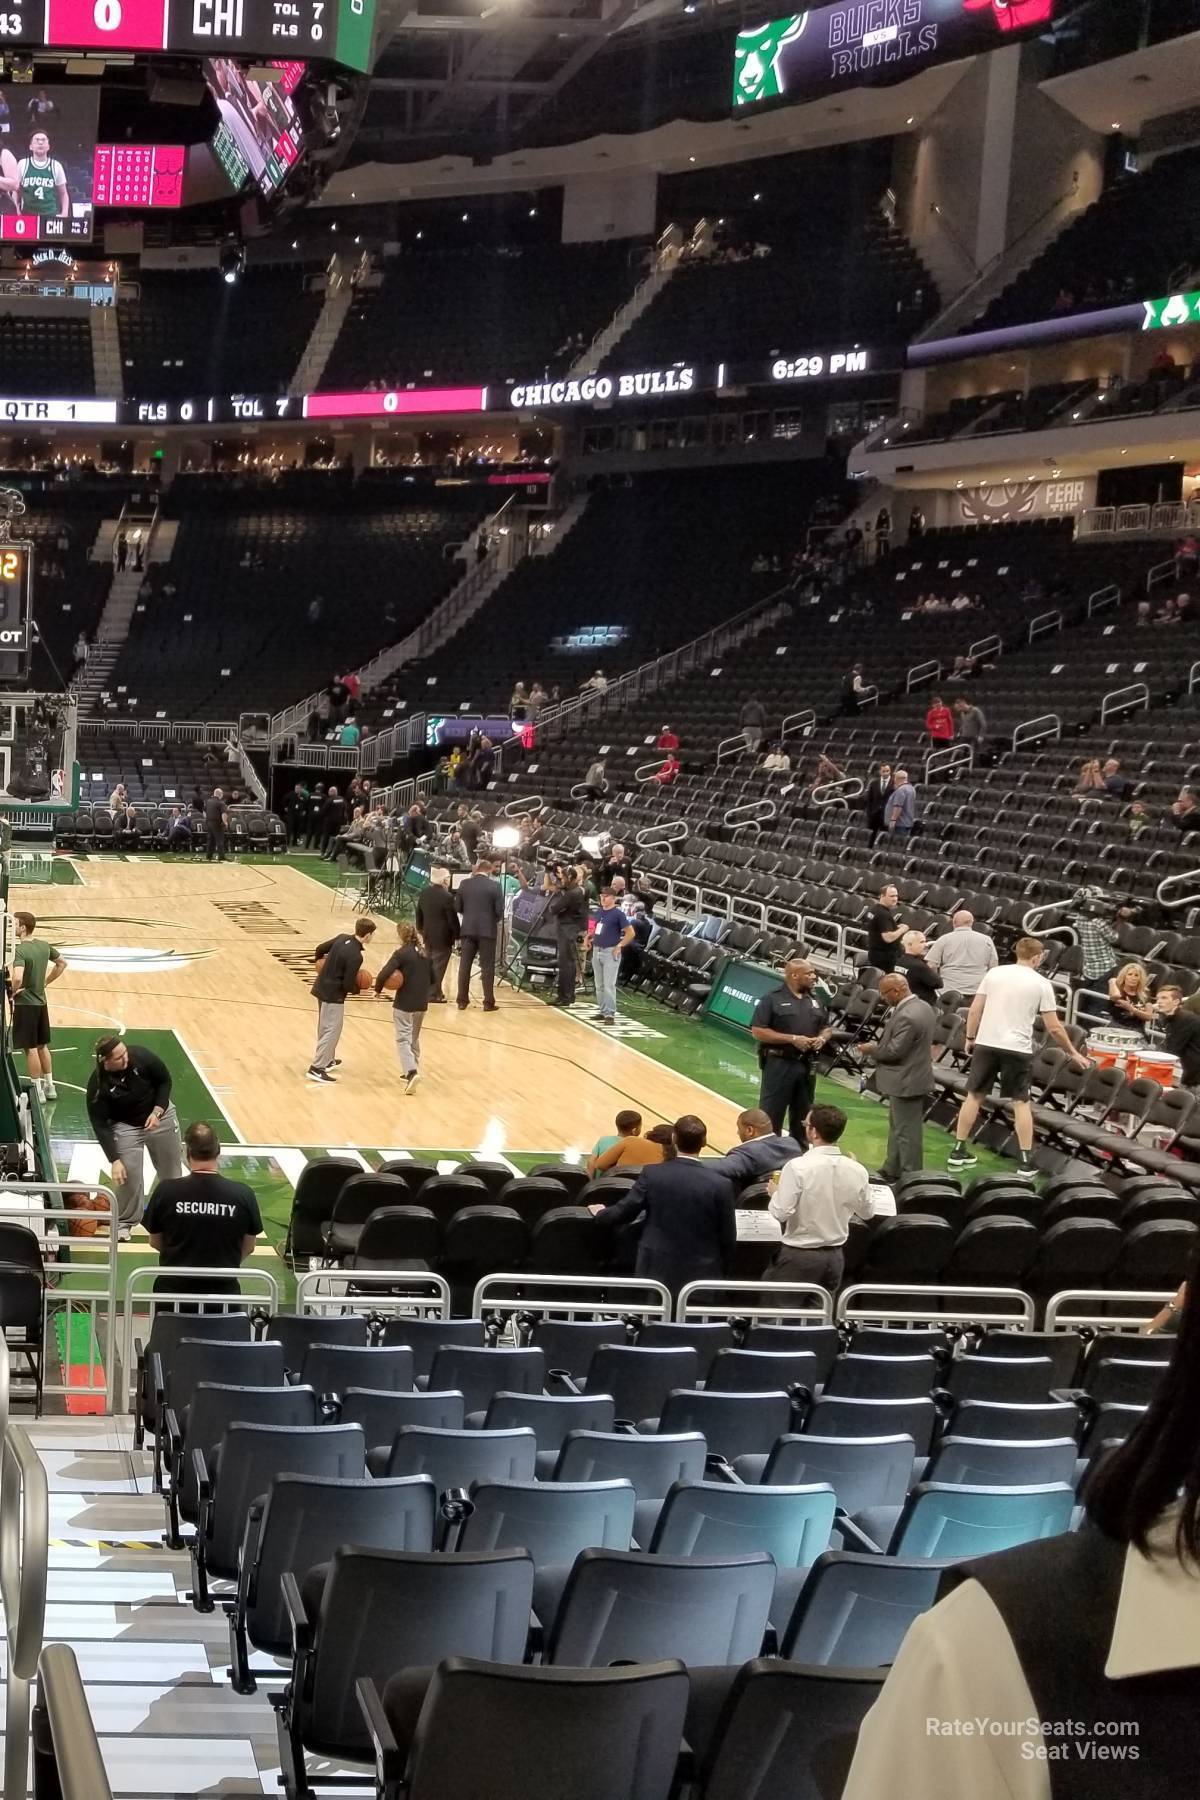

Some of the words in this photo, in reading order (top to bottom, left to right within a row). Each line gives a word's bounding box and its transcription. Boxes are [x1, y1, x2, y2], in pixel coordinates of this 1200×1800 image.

[93, 0, 122, 31] 0
[193, 0, 243, 36] CHI
[273, 3, 300, 16] TOL
[312, 3, 325, 20] 7
[272, 24, 298, 36] FLS
[310, 24, 323, 40] 0
[829, 0, 922, 48] BUCKS
[830, 24, 938, 79] BULLS
[23, 177, 54, 187] BUCKS
[34, 187, 44, 199] 4
[15, 219, 25, 234] 0
[46, 220, 63, 234] CHI
[772, 355, 823, 379] 6:29
[829, 351, 867, 374] PM
[510, 380, 613, 407] CHICAGO
[618, 367, 694, 396] BULLS
[5, 401, 49, 419] QTR
[67, 403, 76, 419] 1
[139, 402, 167, 420] FLS
[180, 402, 193, 420] 0
[232, 401, 263, 417] TOL
[275, 399, 288, 416] 7
[383, 392, 398, 412] 0
[1045, 480, 1085, 504] FEAR
[176, 1201, 236, 1217] SECURITY
